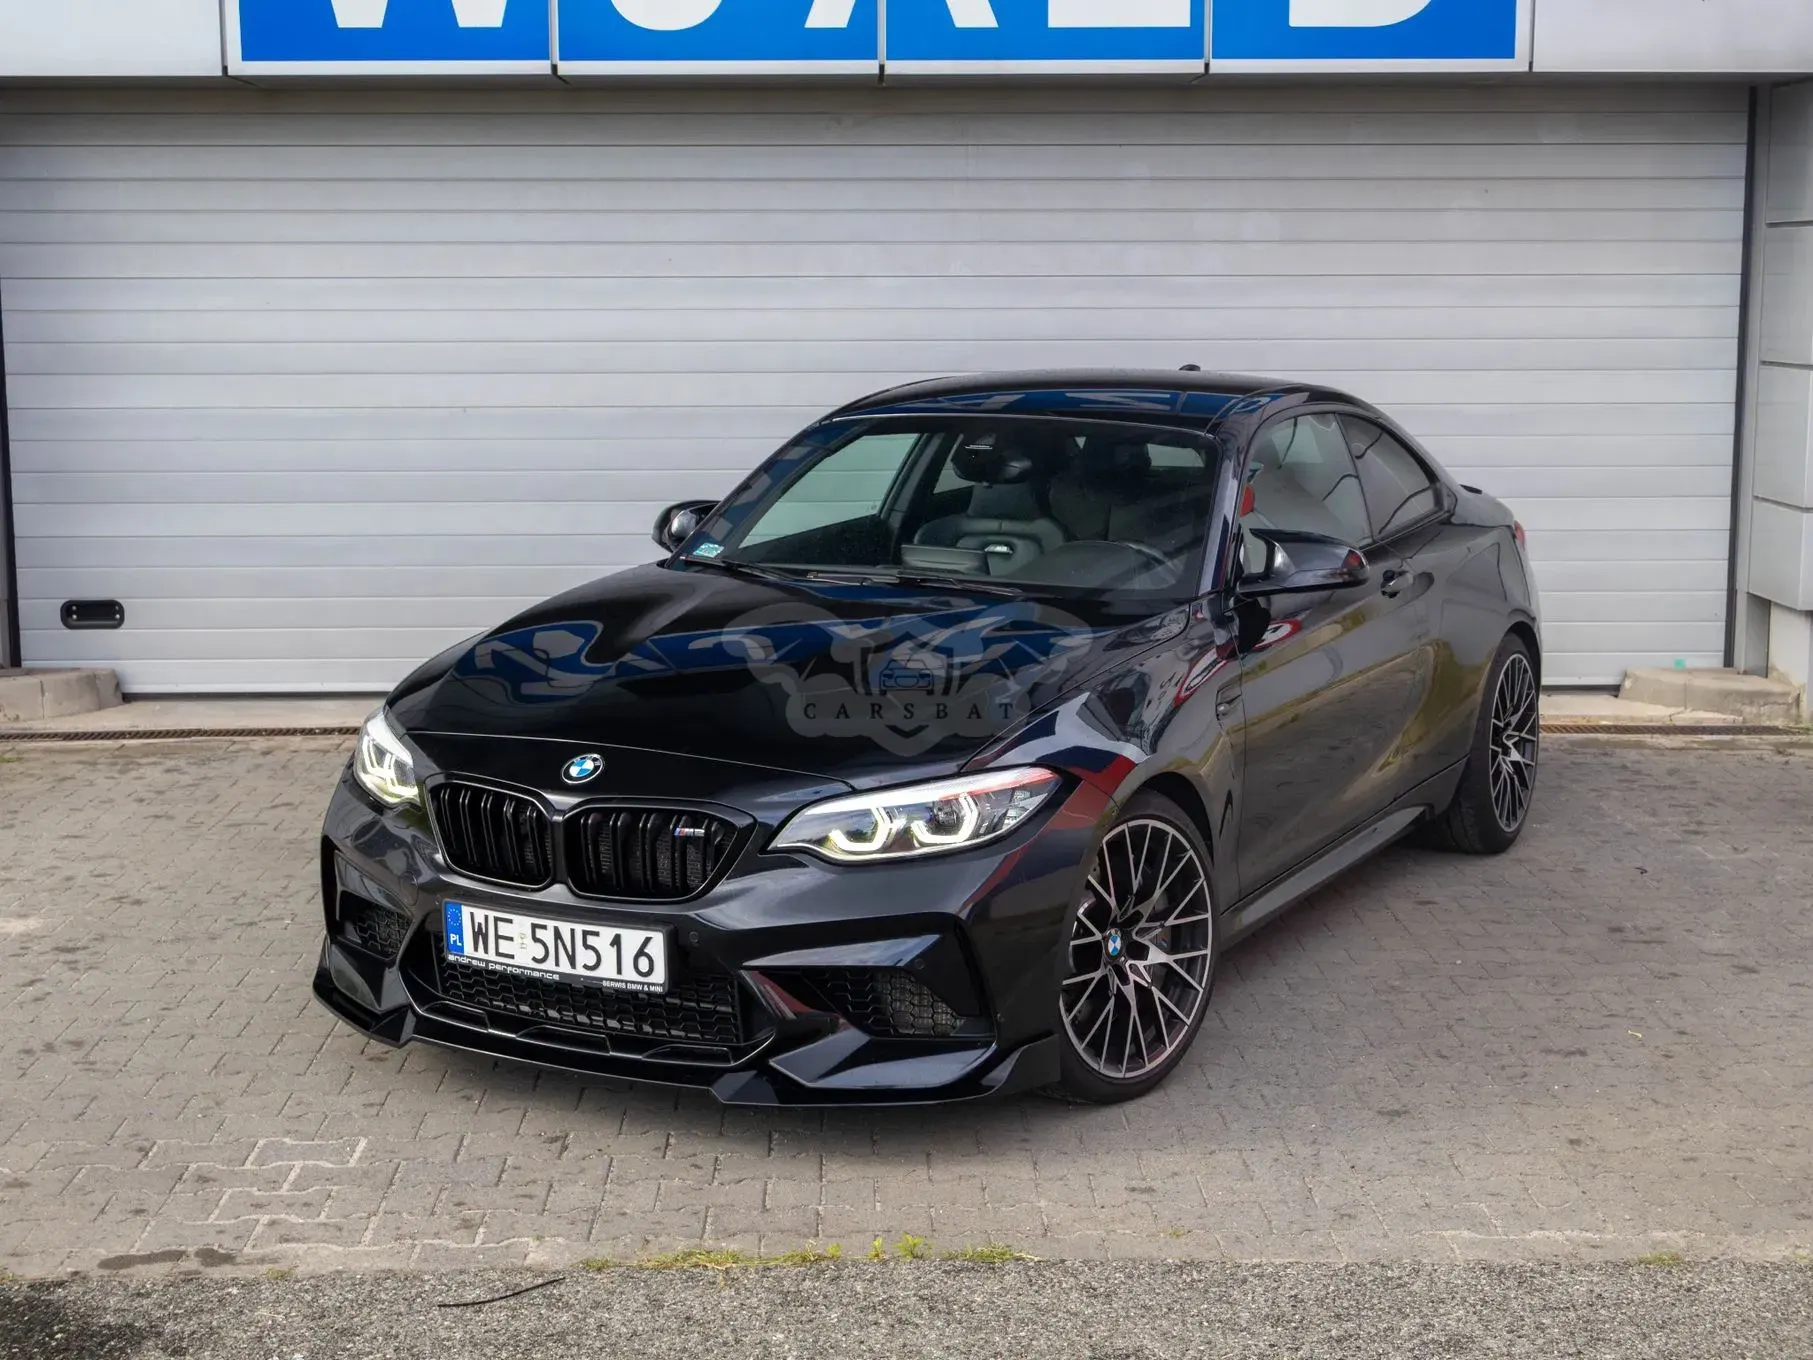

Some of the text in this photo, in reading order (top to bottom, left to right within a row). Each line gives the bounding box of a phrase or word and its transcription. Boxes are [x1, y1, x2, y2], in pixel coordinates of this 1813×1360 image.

[450, 933, 462, 946] PL
[470, 911, 655, 978] WE 5N516
[448, 954, 560, 980] andrew performance
